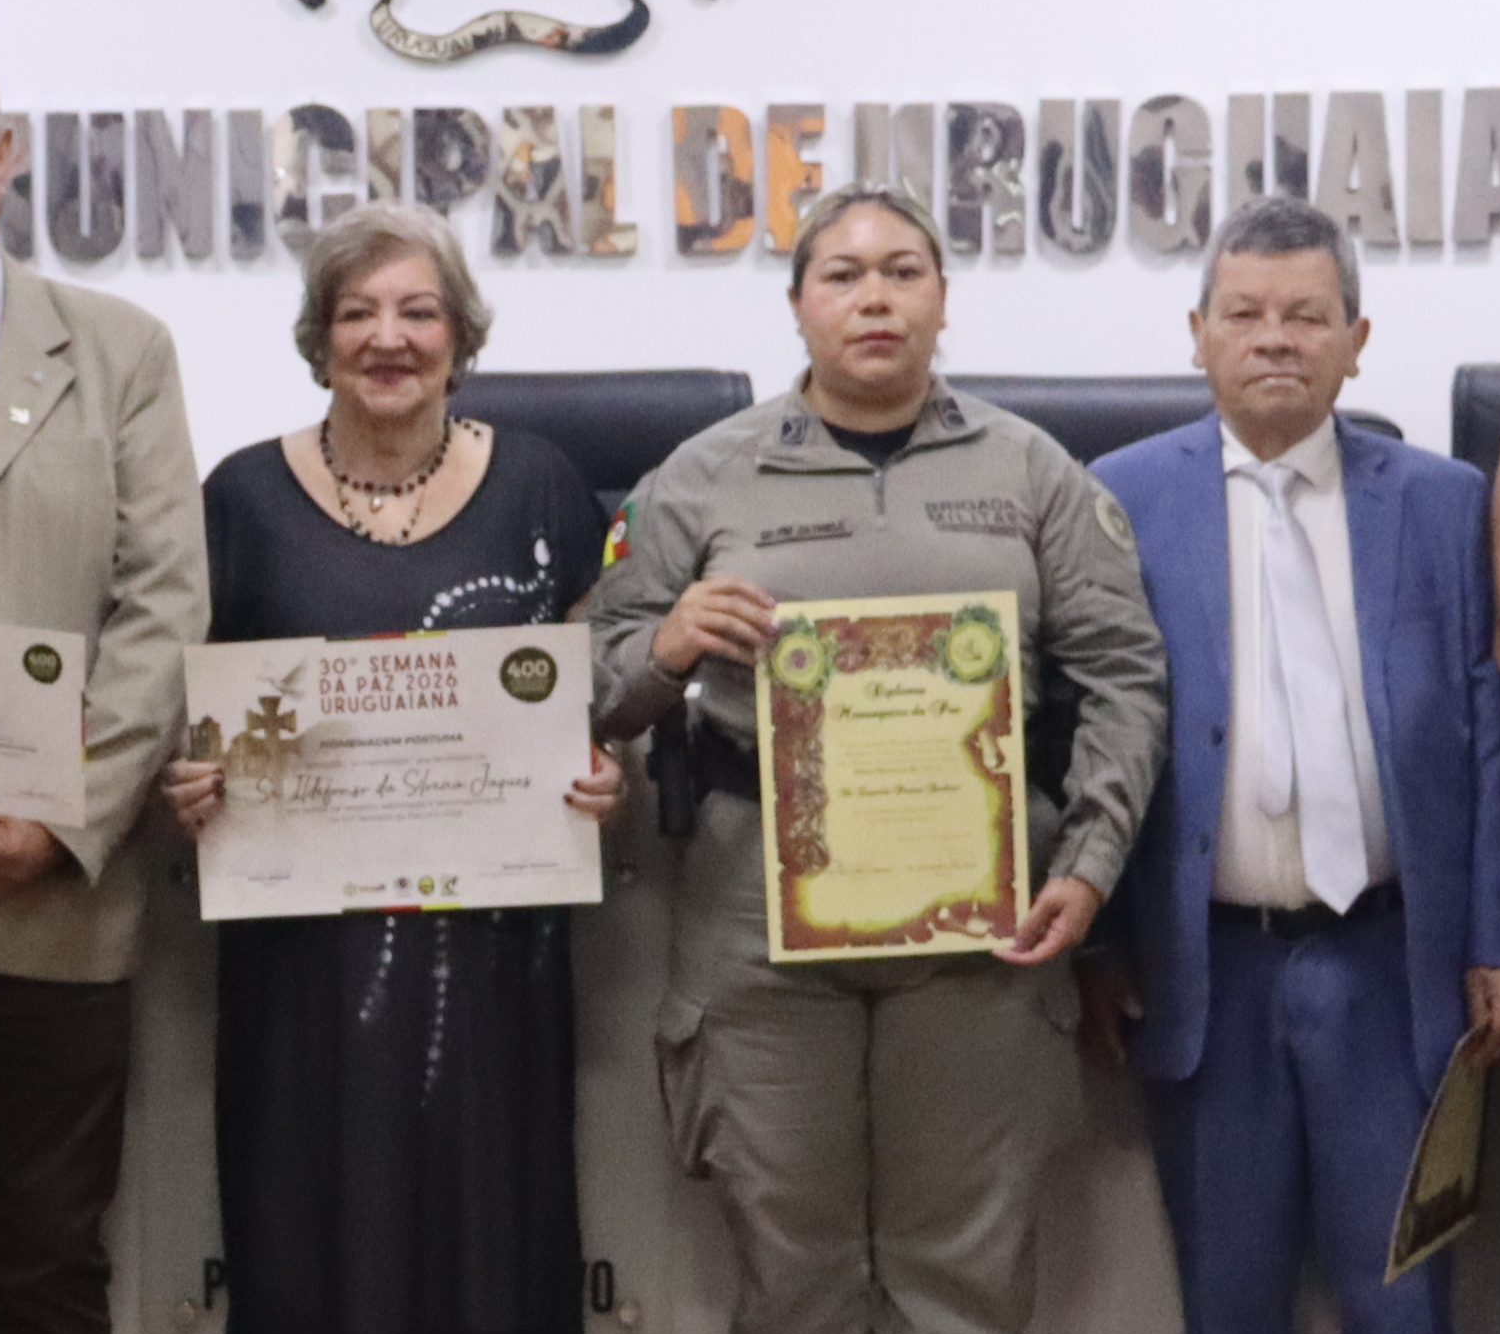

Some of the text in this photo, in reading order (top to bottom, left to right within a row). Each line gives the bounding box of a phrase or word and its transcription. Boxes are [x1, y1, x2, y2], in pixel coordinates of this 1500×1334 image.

[673, 103, 826, 257] DE
[369, 651, 457, 672] SEMANA
[319, 671, 458, 695] DA PAZ 2026
[320, 691, 459, 715] URUGUAIANA
